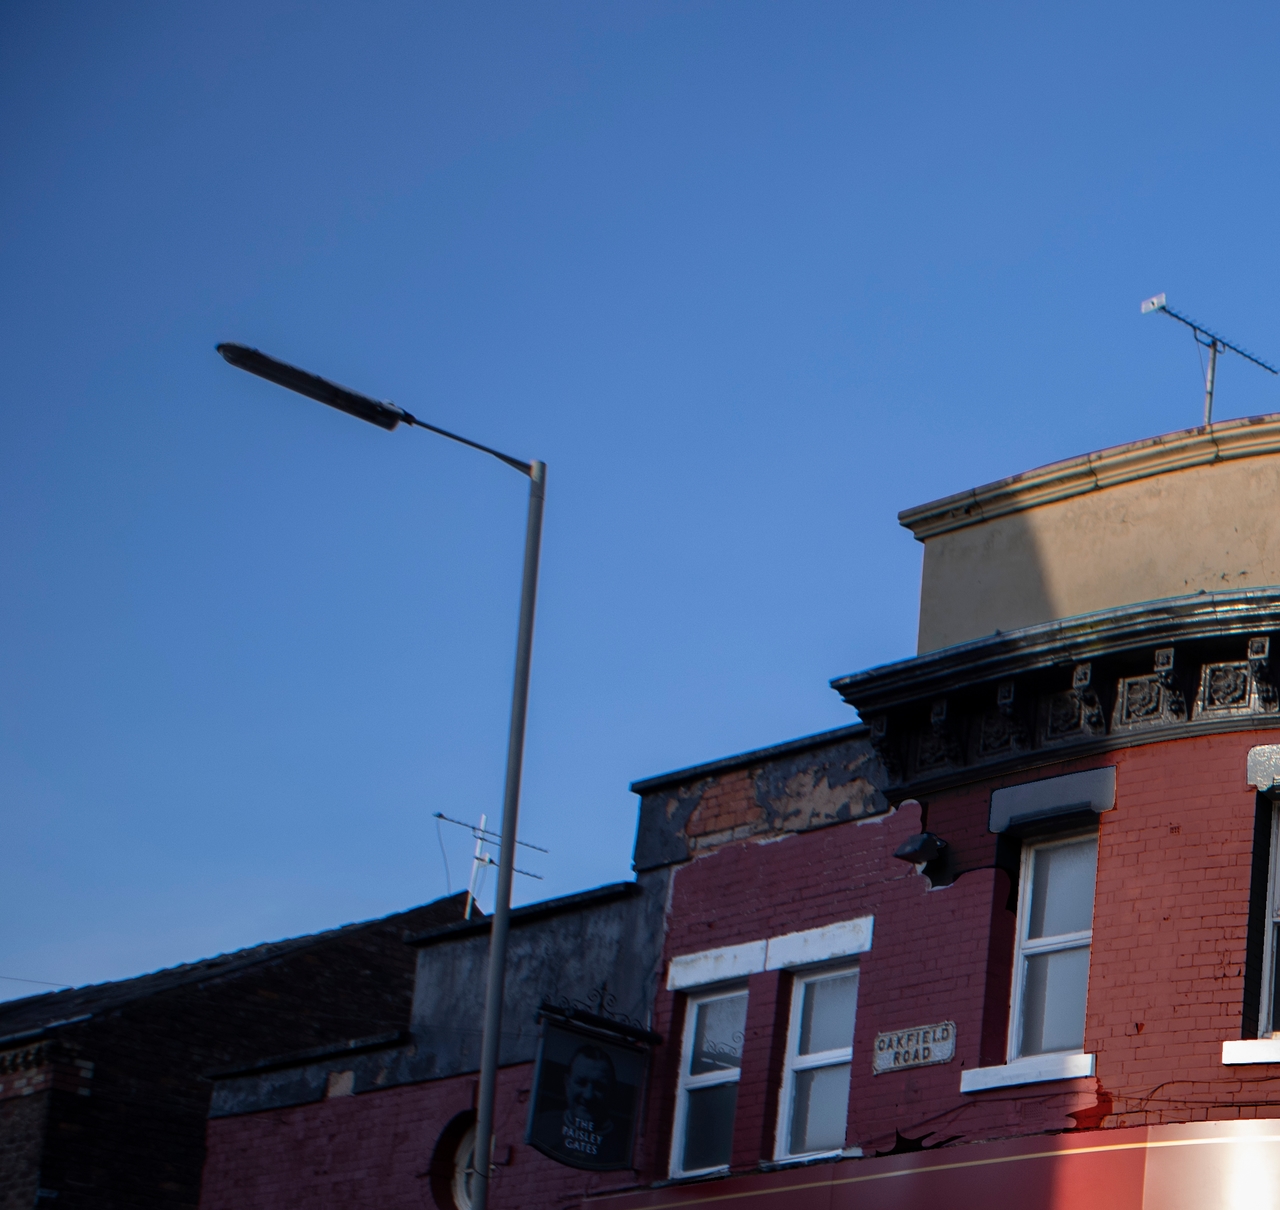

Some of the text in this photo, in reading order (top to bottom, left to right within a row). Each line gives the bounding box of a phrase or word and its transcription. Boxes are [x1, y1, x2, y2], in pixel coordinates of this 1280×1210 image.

[878, 1028, 949, 1052] OAKFIELD
[893, 1046, 930, 1066] ROAD
[561, 1125, 603, 1145] PAISLEY
[574, 1118, 596, 1132] THE
[564, 1138, 598, 1155] GATES
